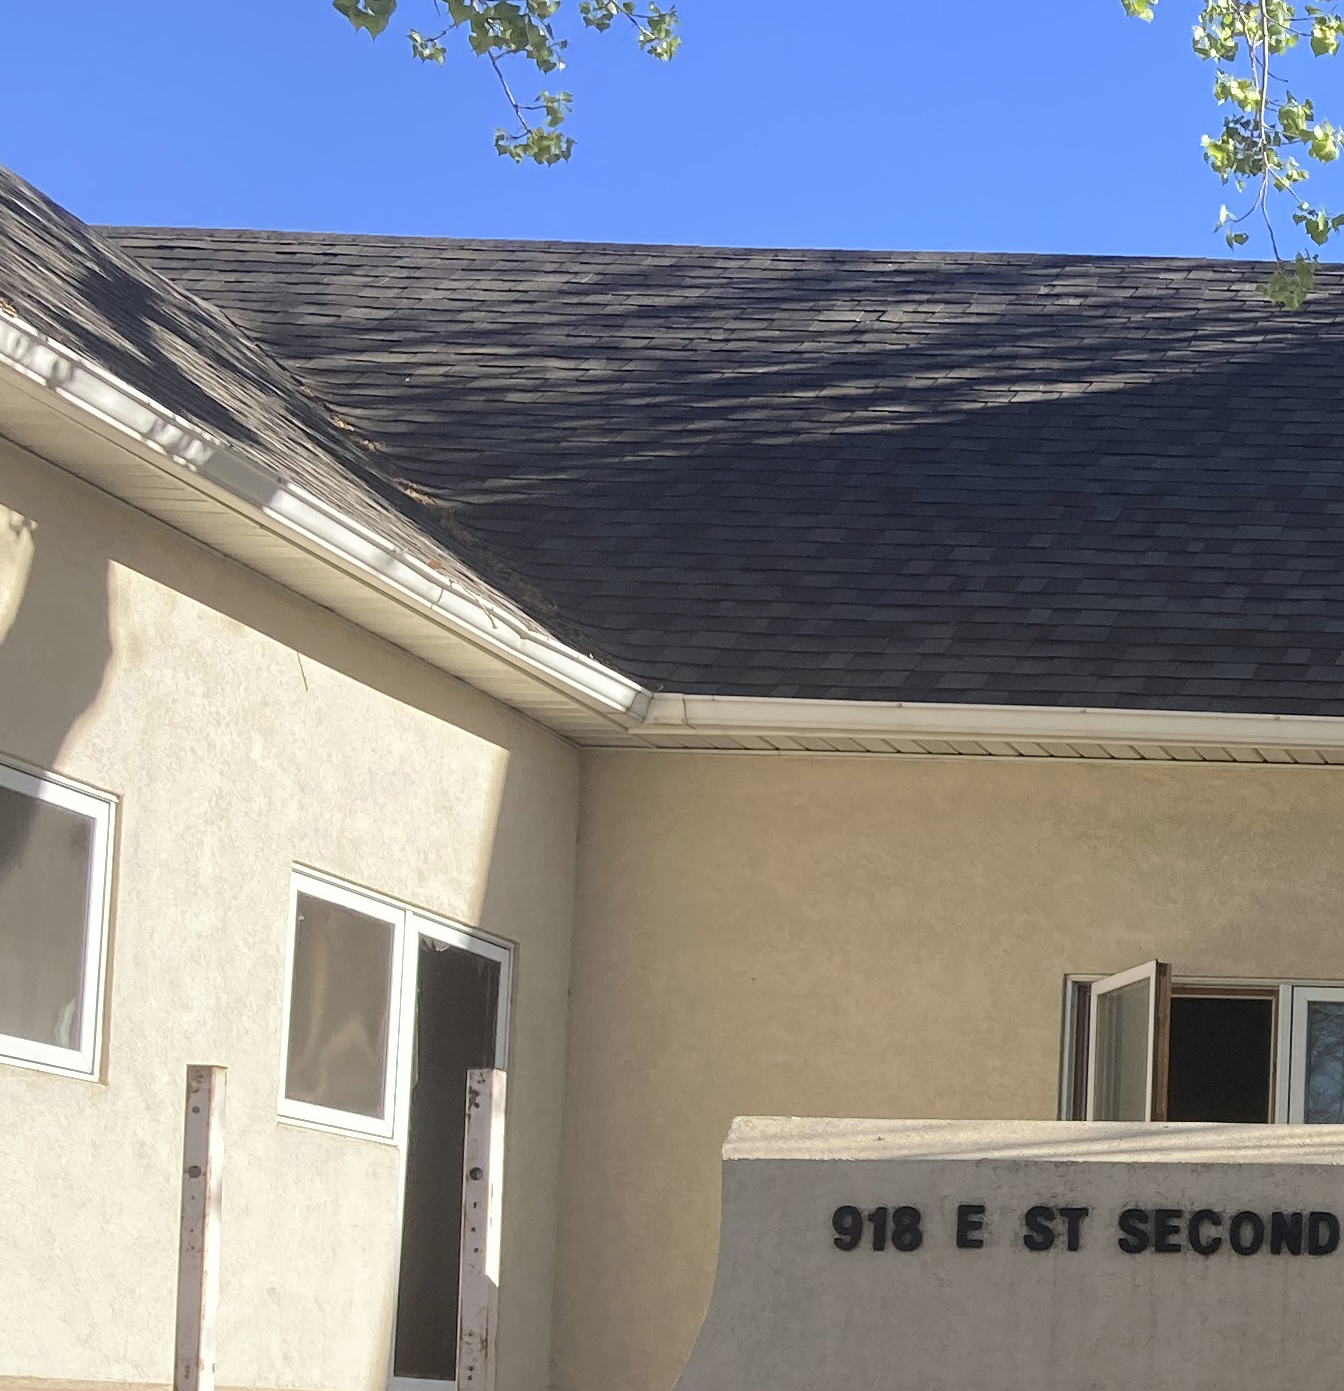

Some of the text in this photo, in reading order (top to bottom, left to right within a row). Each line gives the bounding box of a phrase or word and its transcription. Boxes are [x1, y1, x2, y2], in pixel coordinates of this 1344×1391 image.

[831, 1204, 1341, 1257] 918 E ST SECOND
